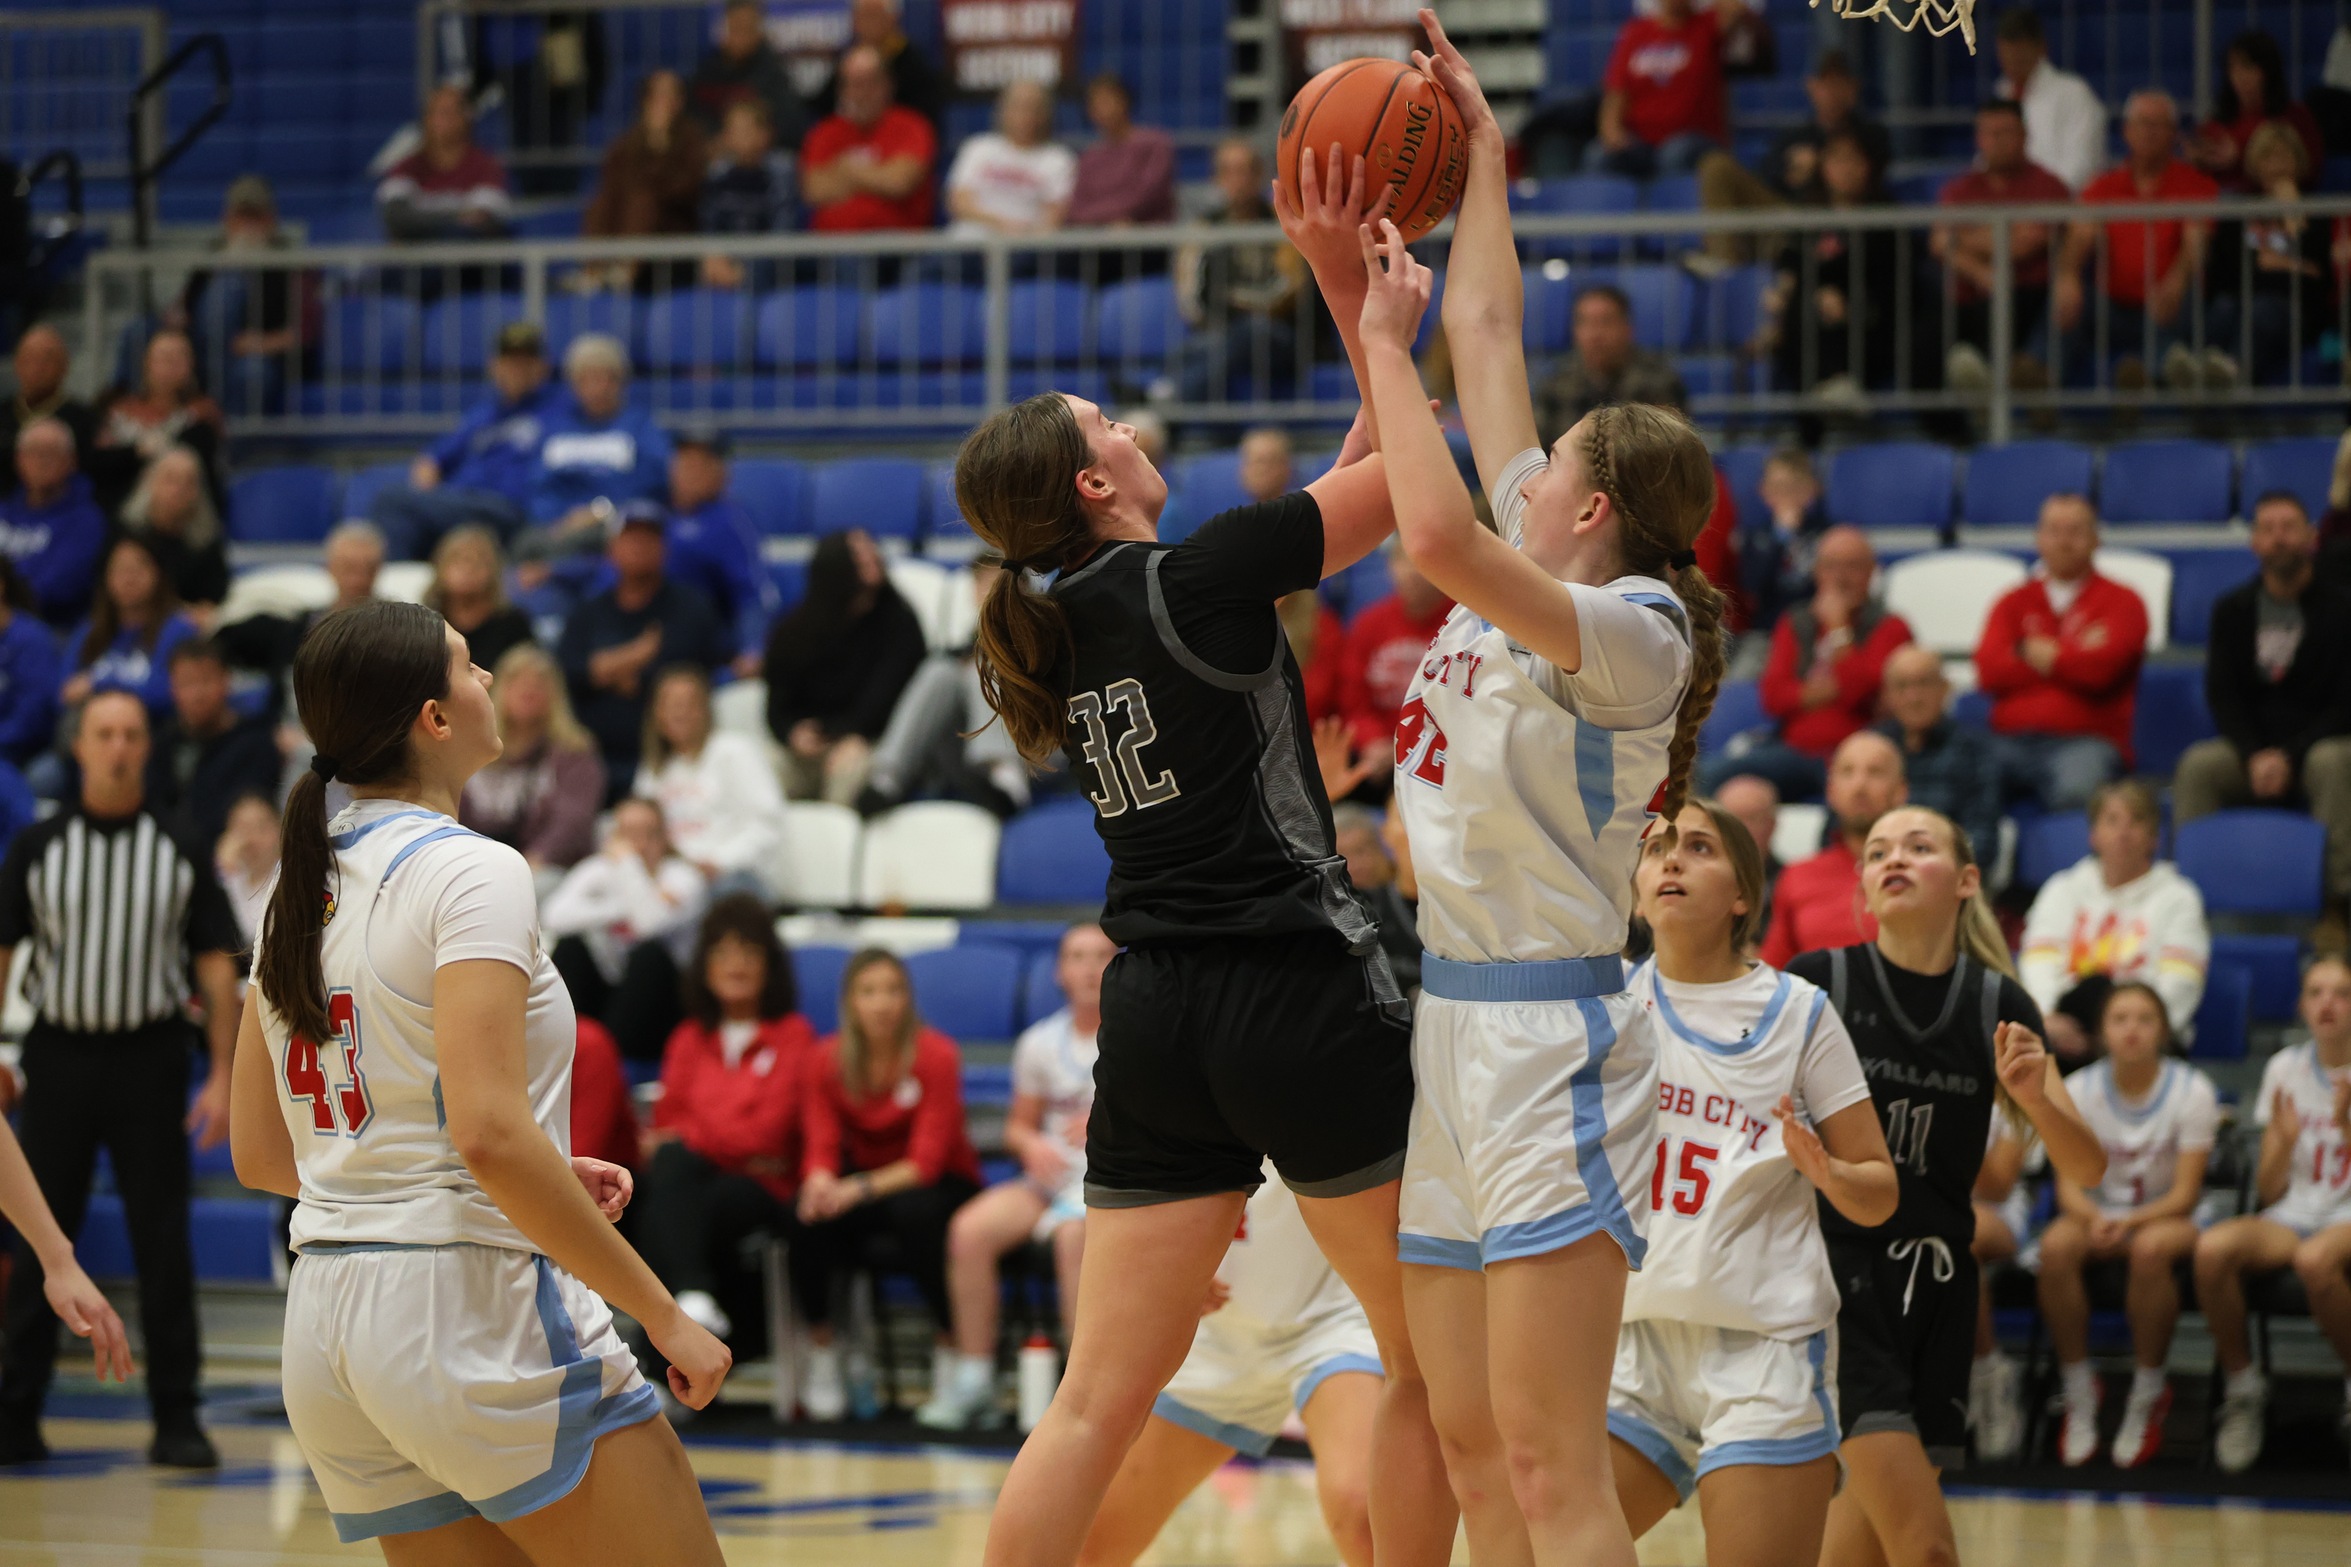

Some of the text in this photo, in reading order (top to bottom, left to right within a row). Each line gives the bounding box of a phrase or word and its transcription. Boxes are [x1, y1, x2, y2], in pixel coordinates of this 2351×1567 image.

[1383, 101, 1434, 217] ALDING
[1422, 650, 1484, 701] CTY
[1067, 678, 1181, 818] 32
[281, 985, 375, 1139] 43
[1860, 1057, 1979, 1096] WILLARD
[1650, 1133, 1722, 1220] 15
[1886, 1097, 1935, 1176] 11
